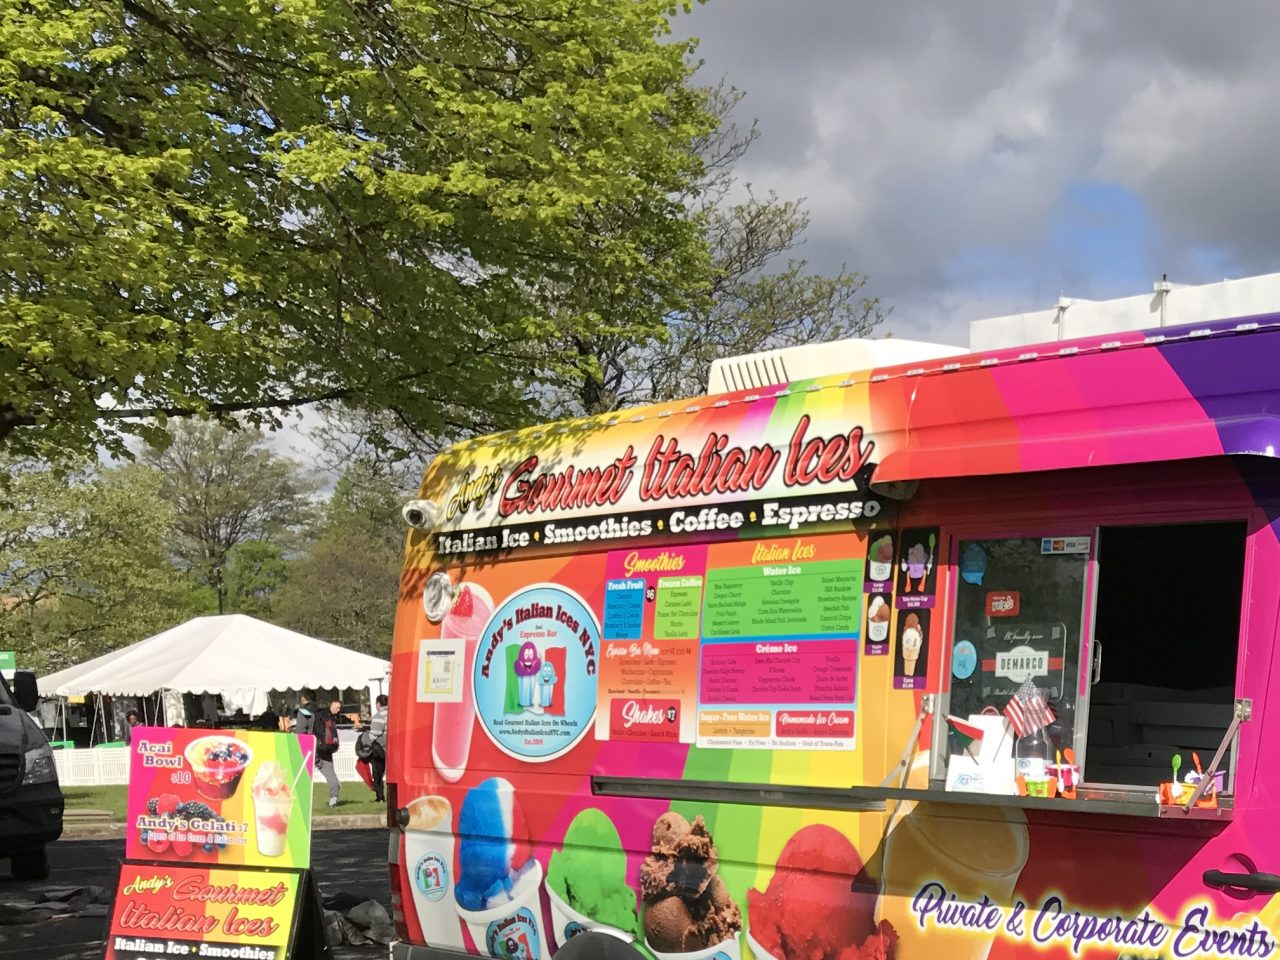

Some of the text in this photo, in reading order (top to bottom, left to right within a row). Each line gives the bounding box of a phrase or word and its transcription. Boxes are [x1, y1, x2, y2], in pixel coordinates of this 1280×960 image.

[446, 413, 875, 520] Andy's Gourmet Italian Ices
[438, 500, 881, 555] Italian Ice Smoothies Coffee Espresso
[751, 537, 817, 564] Italian Ices
[623, 551, 686, 578] Smoothies
[763, 565, 802, 576] Water Ice
[607, 580, 643, 591] Fresh Fruit
[481, 617, 513, 679] Andy's
[515, 602, 554, 624] Italian
[555, 604, 580, 635] Ices
[578, 627, 597, 677] NYC
[784, 643, 798, 653] Ice
[621, 700, 666, 729] Shakes
[758, 712, 770, 722] Ice
[778, 711, 850, 727] Homemade Ice Cream
[138, 741, 172, 754] Acai
[145, 755, 182, 768] Bowl
[171, 772, 191, 784] $10
[137, 817, 187, 832] Andy's
[190, 819, 236, 832] Gelati
[123, 874, 288, 907] Andy's Gourmet
[119, 901, 279, 937] Italian Ices
[912, 882, 1277, 959] Private & Corporate Events
[114, 938, 275, 960] Italian Ice Smoothies
